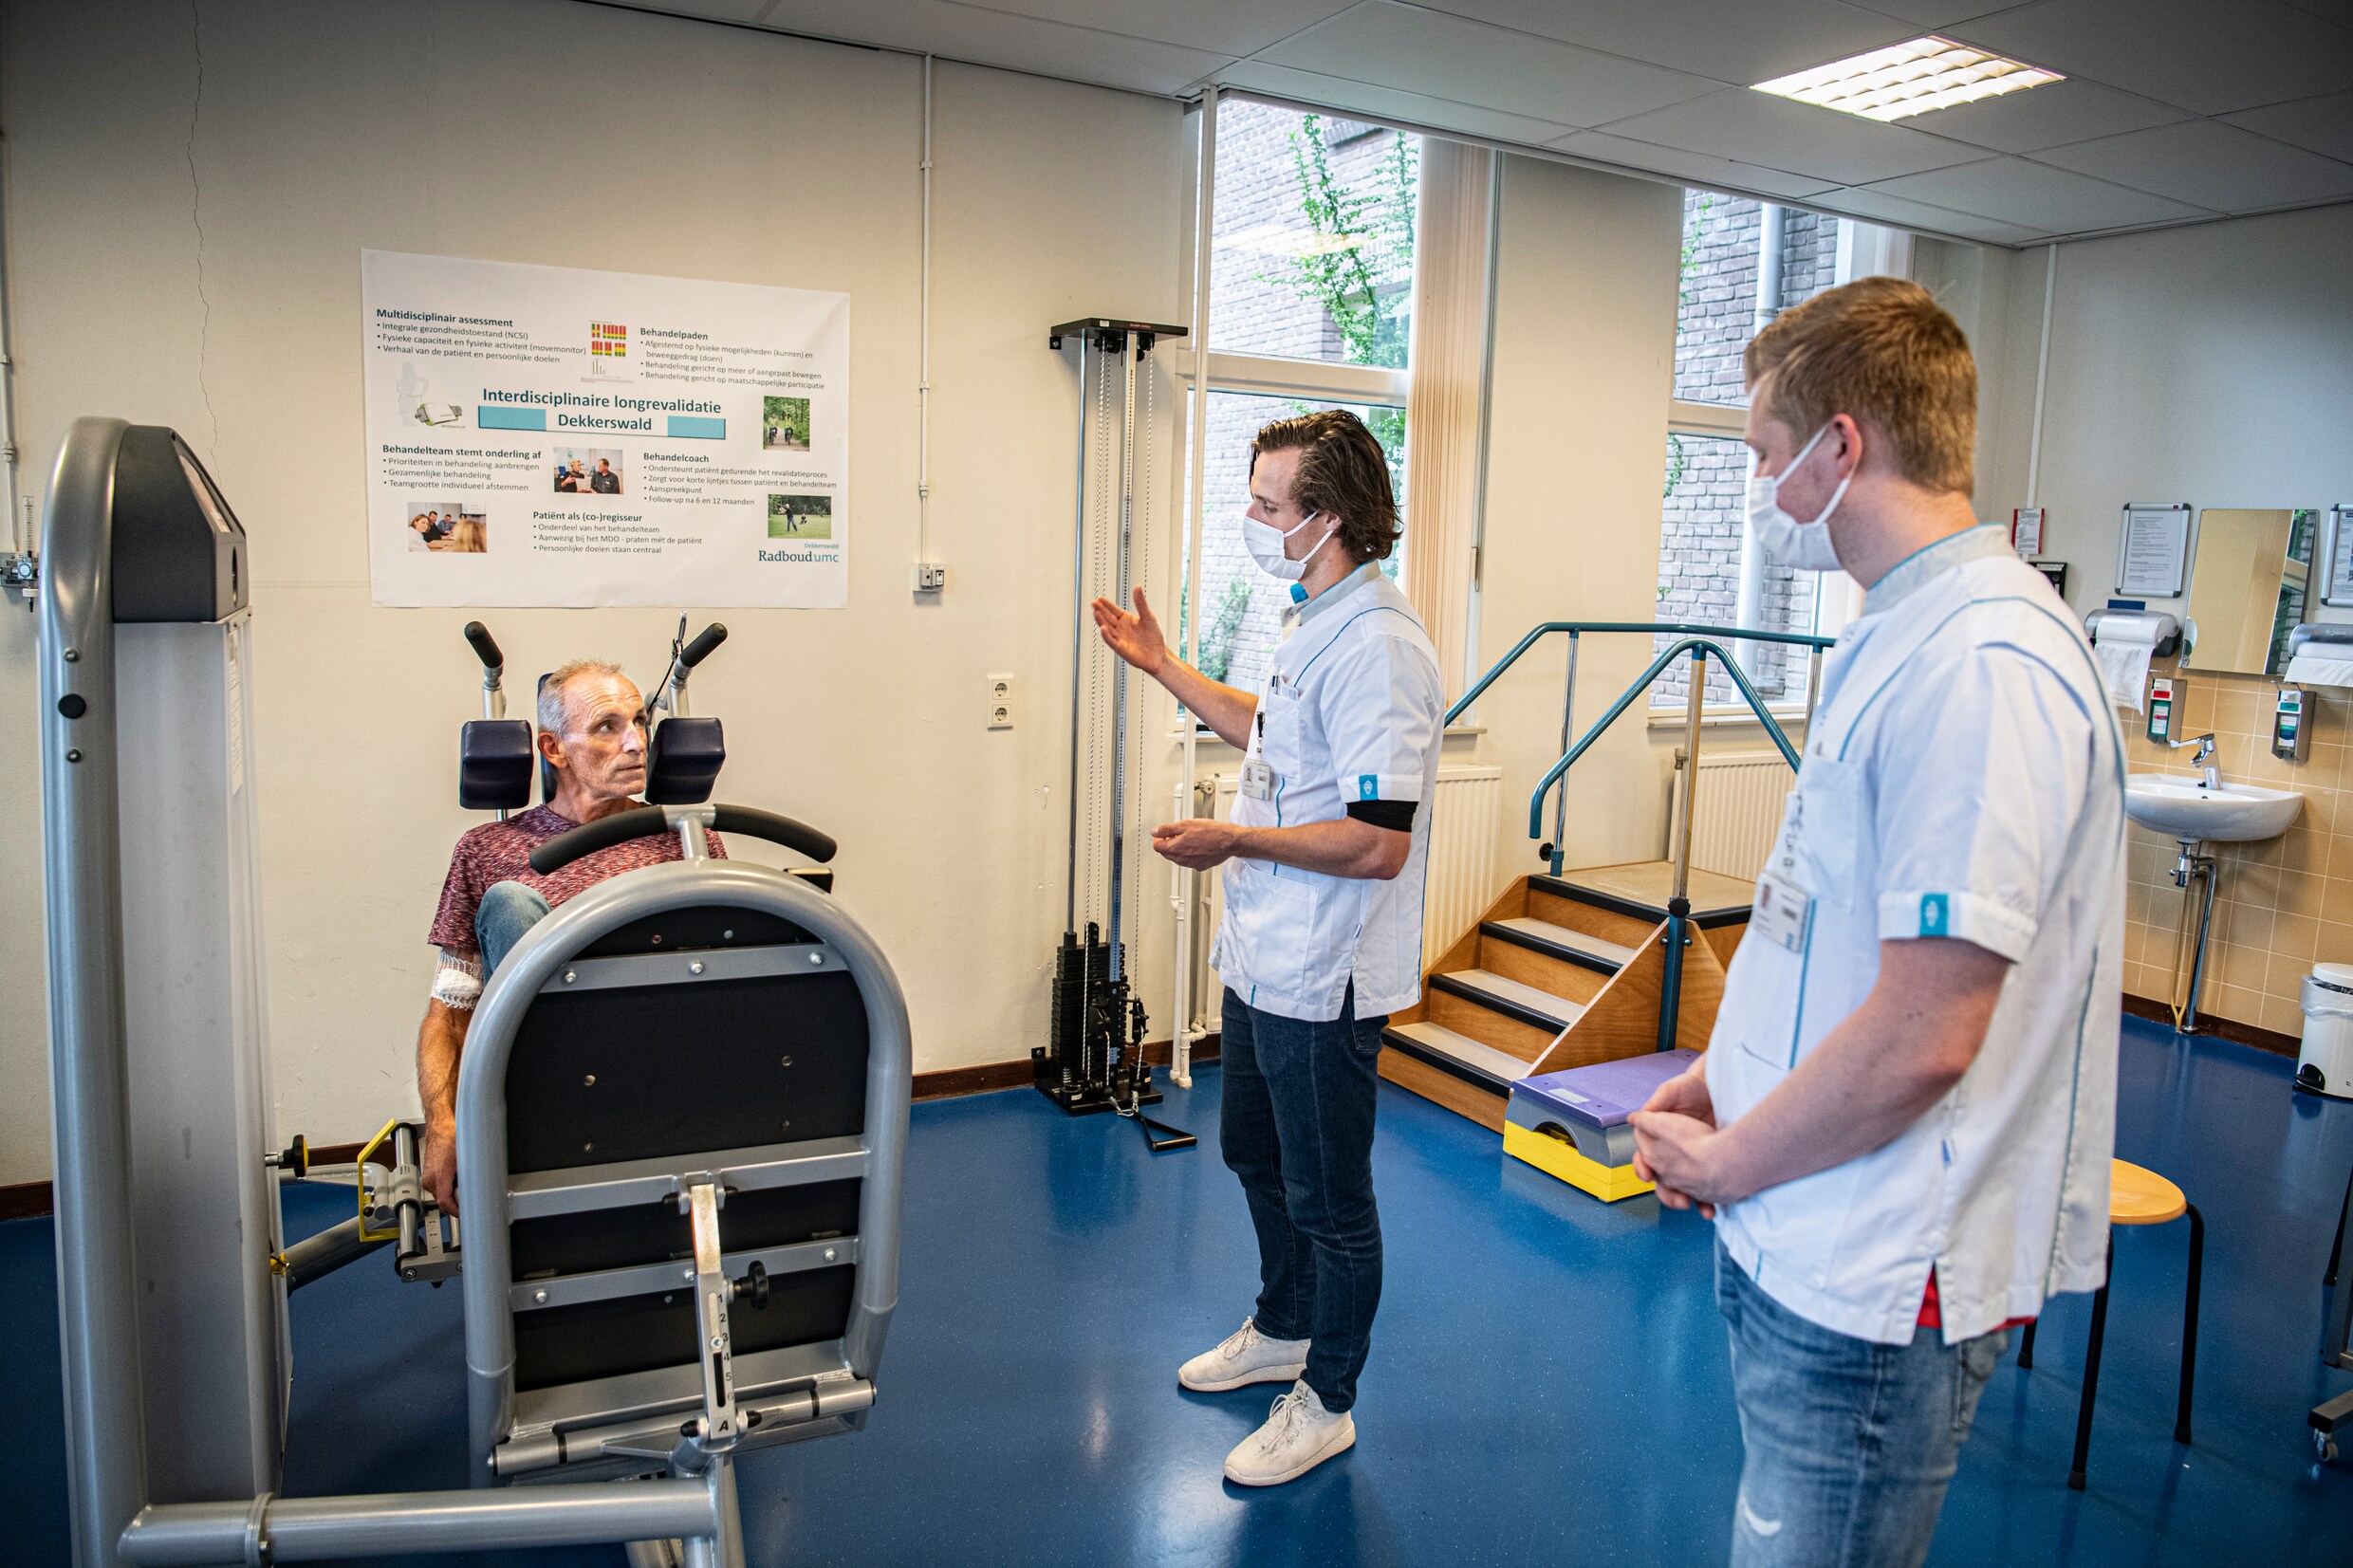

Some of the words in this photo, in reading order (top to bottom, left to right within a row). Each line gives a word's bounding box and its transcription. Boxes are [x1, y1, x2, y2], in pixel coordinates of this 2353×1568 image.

[377, 309, 455, 323] Multidisciplinair
[459, 317, 512, 327] assessment
[382, 323, 417, 332] Integrale
[420, 326, 503, 338] gezondheidstoestand
[505, 331, 528, 341] (NCSI)
[640, 328, 708, 340] Behandelpaden
[383, 334, 412, 342] Fysieke
[467, 339, 492, 347] fysieke
[530, 343, 586, 355] (movemonitor)
[645, 340, 683, 350] Afgestemd
[695, 343, 719, 353] fysieke
[721, 347, 771, 356] mogelijkheden
[773, 349, 804, 359] (kunnen)
[486, 353, 532, 362] persoonlijke
[646, 351, 698, 362] beweeggedrag
[699, 354, 723, 363] (doen)
[646, 361, 690, 372] Behandeling
[792, 371, 822, 379] bewegen
[646, 371, 690, 382] Behandeling
[728, 378, 787, 387] maatschappelijke
[787, 381, 824, 390] participatie
[484, 389, 609, 407] Interdisciplinaire
[615, 396, 721, 413] longrevalidatie
[559, 415, 651, 430] Dekkerswald
[383, 445, 453, 454] Behandelteam
[486, 450, 529, 460] onderling
[644, 452, 709, 462] Behandelcoach
[389, 457, 433, 466] Prioriteiten
[445, 459, 492, 470] behandeling
[494, 462, 539, 470] aanbrengen
[389, 469, 441, 478] Gezamenlijke
[443, 470, 491, 481] behandeling
[649, 475, 667, 484] Zorgt
[687, 476, 705, 485] korte
[707, 477, 729, 486] lijntjes
[389, 480, 439, 489] Teamgrootte
[441, 481, 484, 489] individueel
[649, 486, 702, 494] Aanspreekpunt
[649, 495, 684, 504] Follow-up
[533, 511, 565, 520] Patiënt
[583, 512, 642, 523] (co-)regisseur
[539, 534, 574, 543] Aanwezig
[539, 544, 584, 553] Persoonlijke
[759, 550, 840, 563] Radboudumc
[718, 1293, 723, 1302] 1
[720, 1314, 727, 1322] 2
[722, 1333, 729, 1341] 3
[724, 1353, 731, 1361] 4
[726, 1373, 732, 1381] 5
[728, 1393, 733, 1401] 6
[719, 1420, 729, 1432] A
